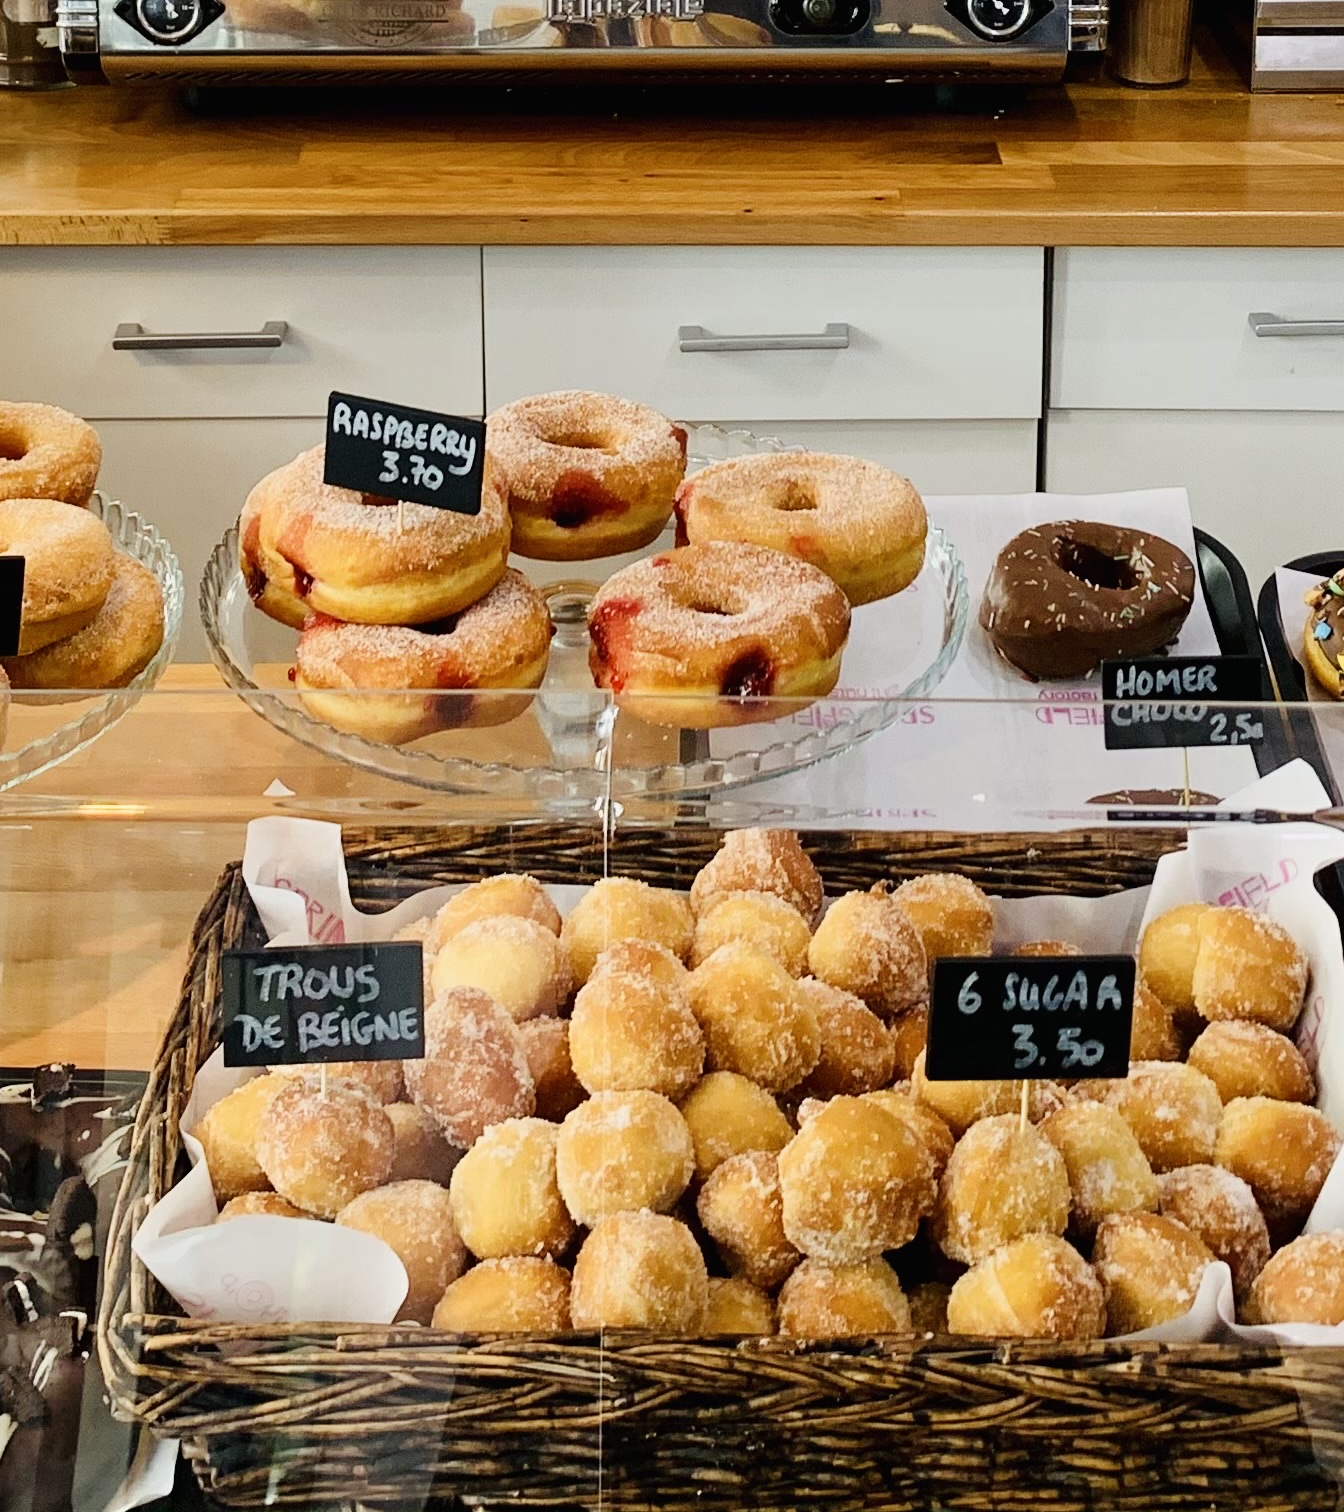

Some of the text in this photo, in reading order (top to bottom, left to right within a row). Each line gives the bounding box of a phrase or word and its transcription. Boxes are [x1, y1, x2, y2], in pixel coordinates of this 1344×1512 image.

[375, 4, 447, 18] RICHARD
[332, 401, 477, 476] RASPBERRY
[378, 450, 444, 491] 3.70
[1116, 665, 1218, 700] HOMER
[252, 962, 381, 1003] TROUS
[957, 969, 1123, 1016] 6 SUGAR
[233, 1013, 286, 1053] DE
[1010, 1023, 1106, 1070] 3.50
